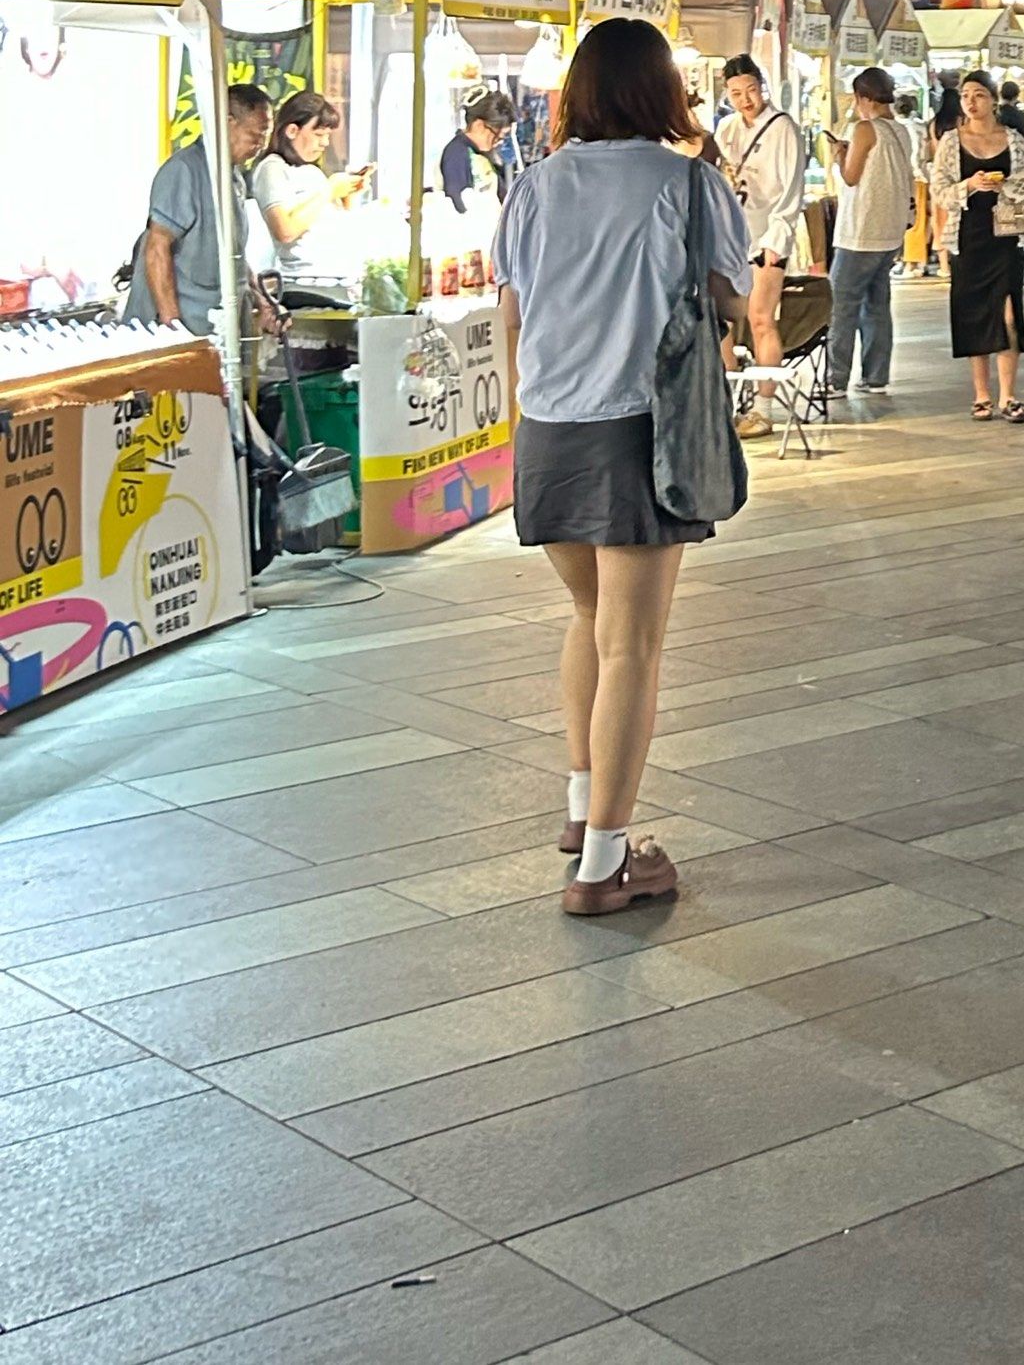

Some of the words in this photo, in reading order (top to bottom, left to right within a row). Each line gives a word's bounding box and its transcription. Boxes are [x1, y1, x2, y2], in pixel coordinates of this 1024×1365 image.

[466, 321, 492, 351] UME
[6, 417, 54, 463] UME
[116, 426, 132, 450] 08
[428, 449, 446, 468] NEW
[150, 537, 199, 571] QINHUAI
[0, 589, 13, 611] OF
[18, 577, 43, 603] LIFE
[150, 562, 202, 596] NANJING
